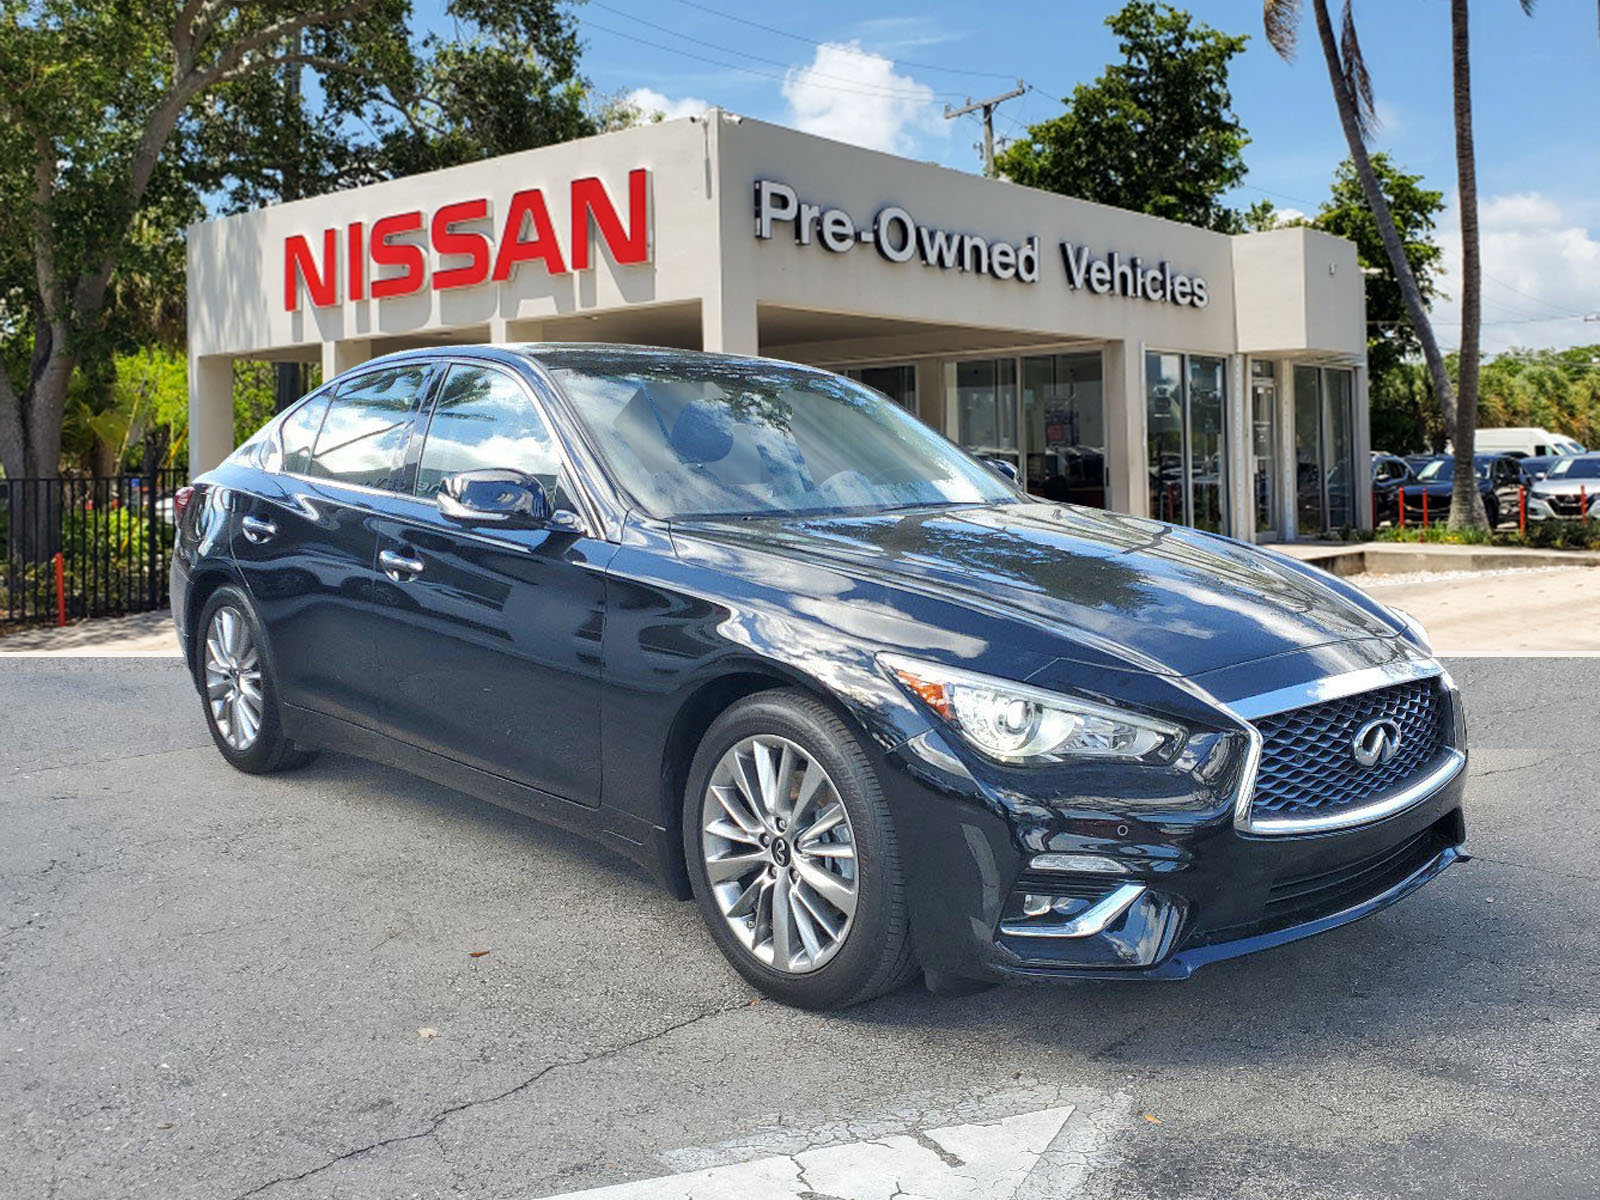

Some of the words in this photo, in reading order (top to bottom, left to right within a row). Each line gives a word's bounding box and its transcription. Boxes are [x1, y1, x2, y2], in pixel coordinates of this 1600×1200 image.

[285, 168, 648, 312] NISSAN
[754, 180, 1040, 284] Pre-Owned
[1060, 241, 1209, 309] Vehicles
